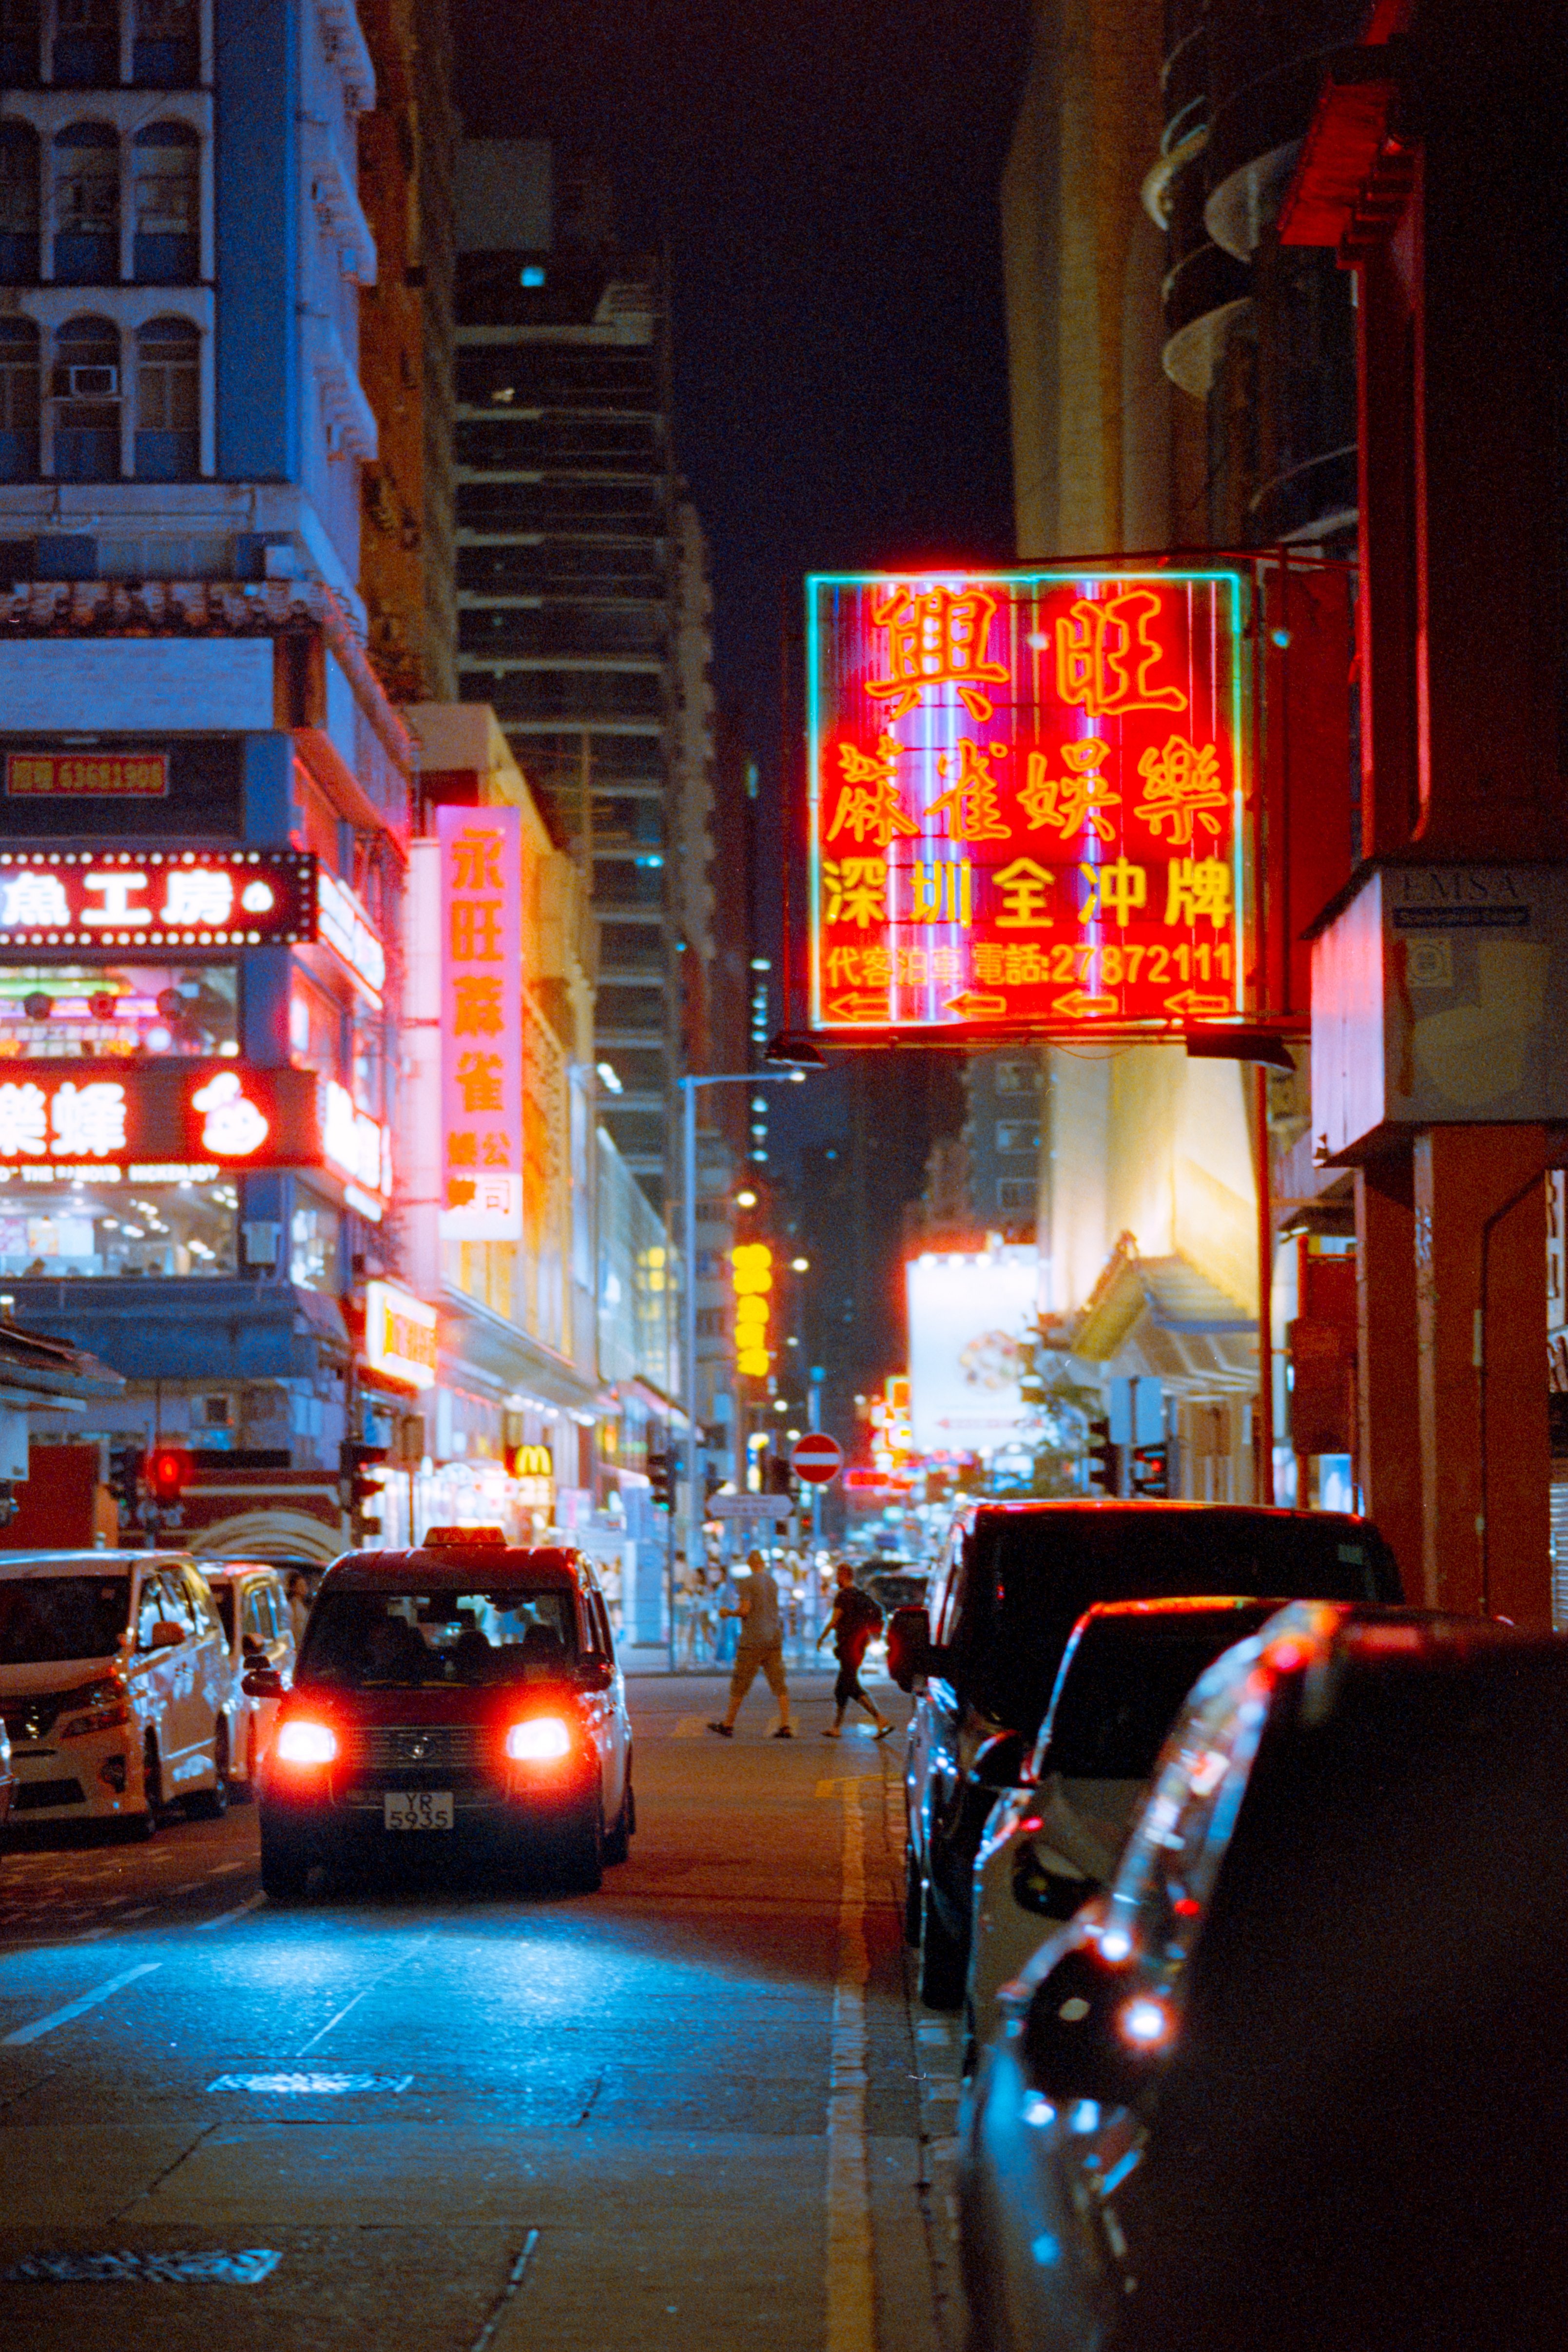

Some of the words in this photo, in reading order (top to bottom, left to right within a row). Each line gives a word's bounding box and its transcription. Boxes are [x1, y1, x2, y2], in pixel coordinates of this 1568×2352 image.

[865, 586, 1188, 721] 興旺
[1404, 872, 1520, 901] EMSA
[21, 1165, 54, 1182] THE
[129, 1164, 220, 1182] HICKENJOY
[432, 1528, 498, 1542] TAXI
[406, 1794, 432, 1810] YR
[390, 1811, 448, 1827] 5935
